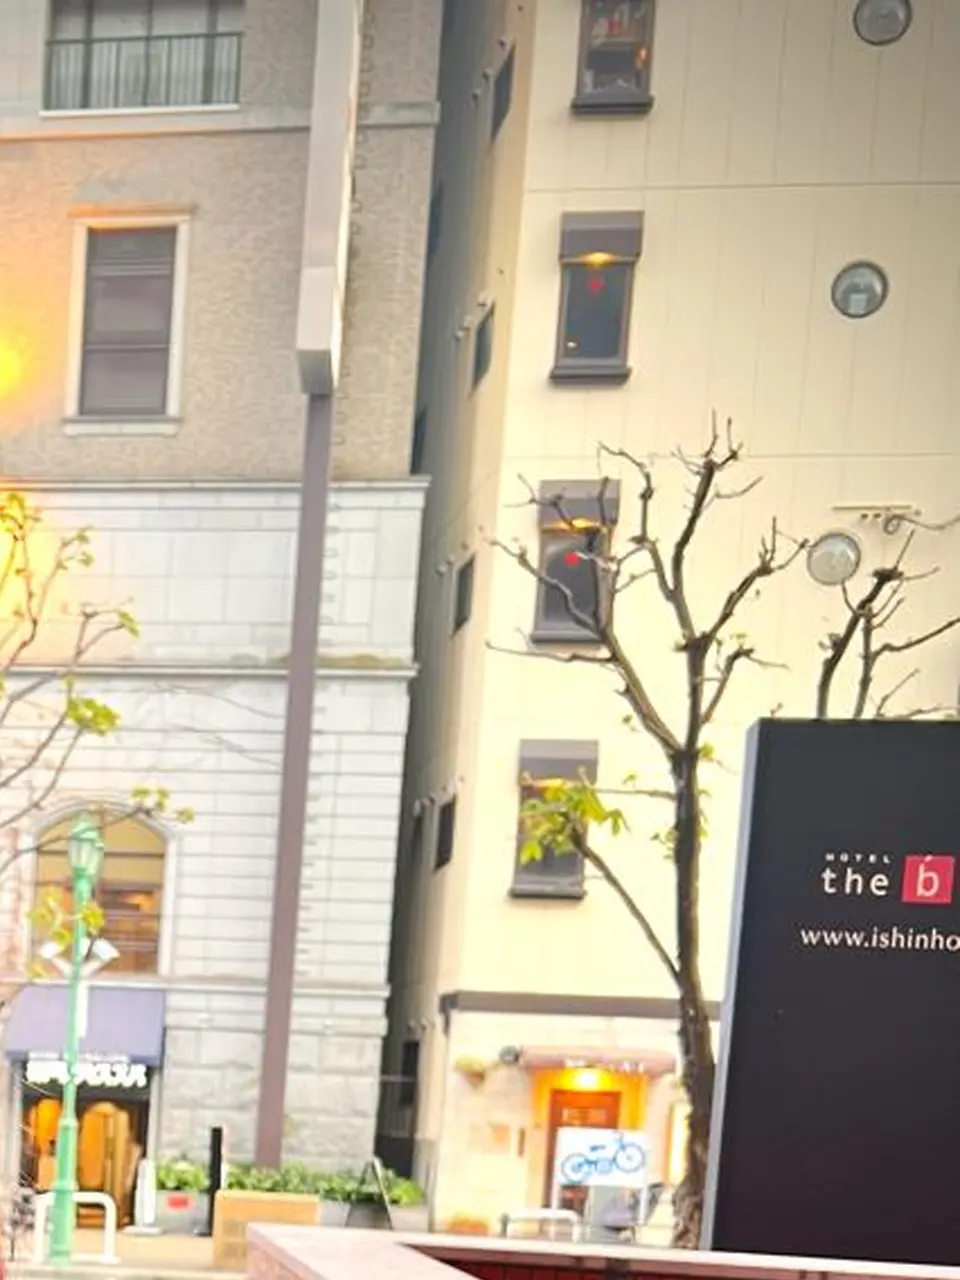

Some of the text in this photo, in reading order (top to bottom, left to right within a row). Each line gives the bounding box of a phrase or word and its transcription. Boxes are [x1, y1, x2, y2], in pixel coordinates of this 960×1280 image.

[825, 853, 890, 863] HOTEL
[821, 867, 889, 896] the
[800, 926, 960, 951] www.ishinho
